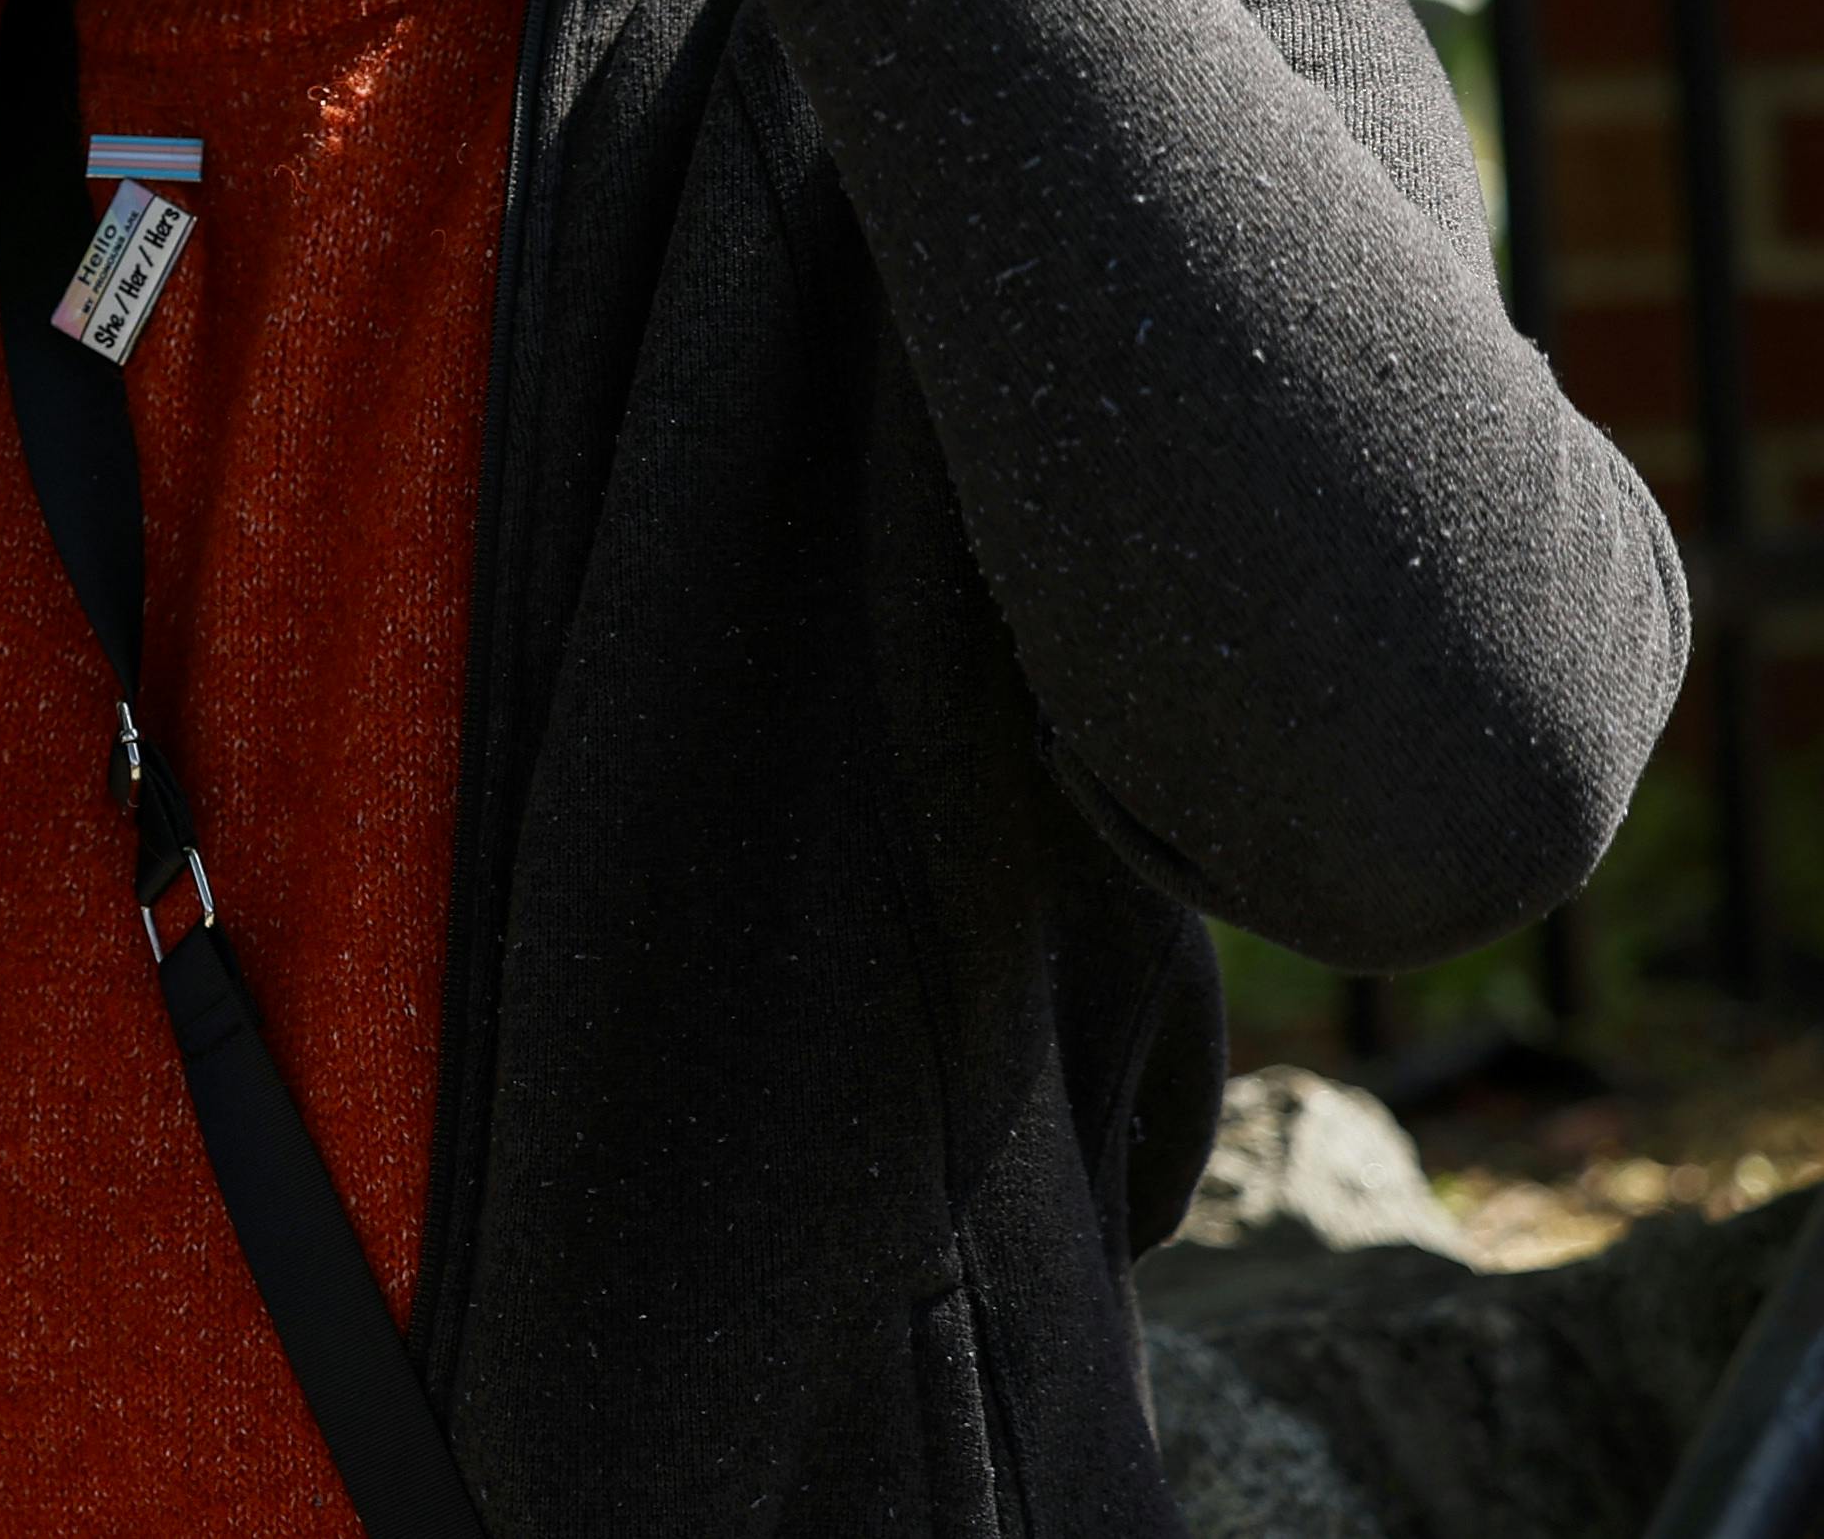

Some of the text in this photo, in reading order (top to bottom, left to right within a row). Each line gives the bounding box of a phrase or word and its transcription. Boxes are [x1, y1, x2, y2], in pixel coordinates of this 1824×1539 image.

[77, 224, 117, 286] Hello
[94, 313, 126, 349] She
[119, 263, 149, 299] Her
[144, 208, 181, 250] Hers
